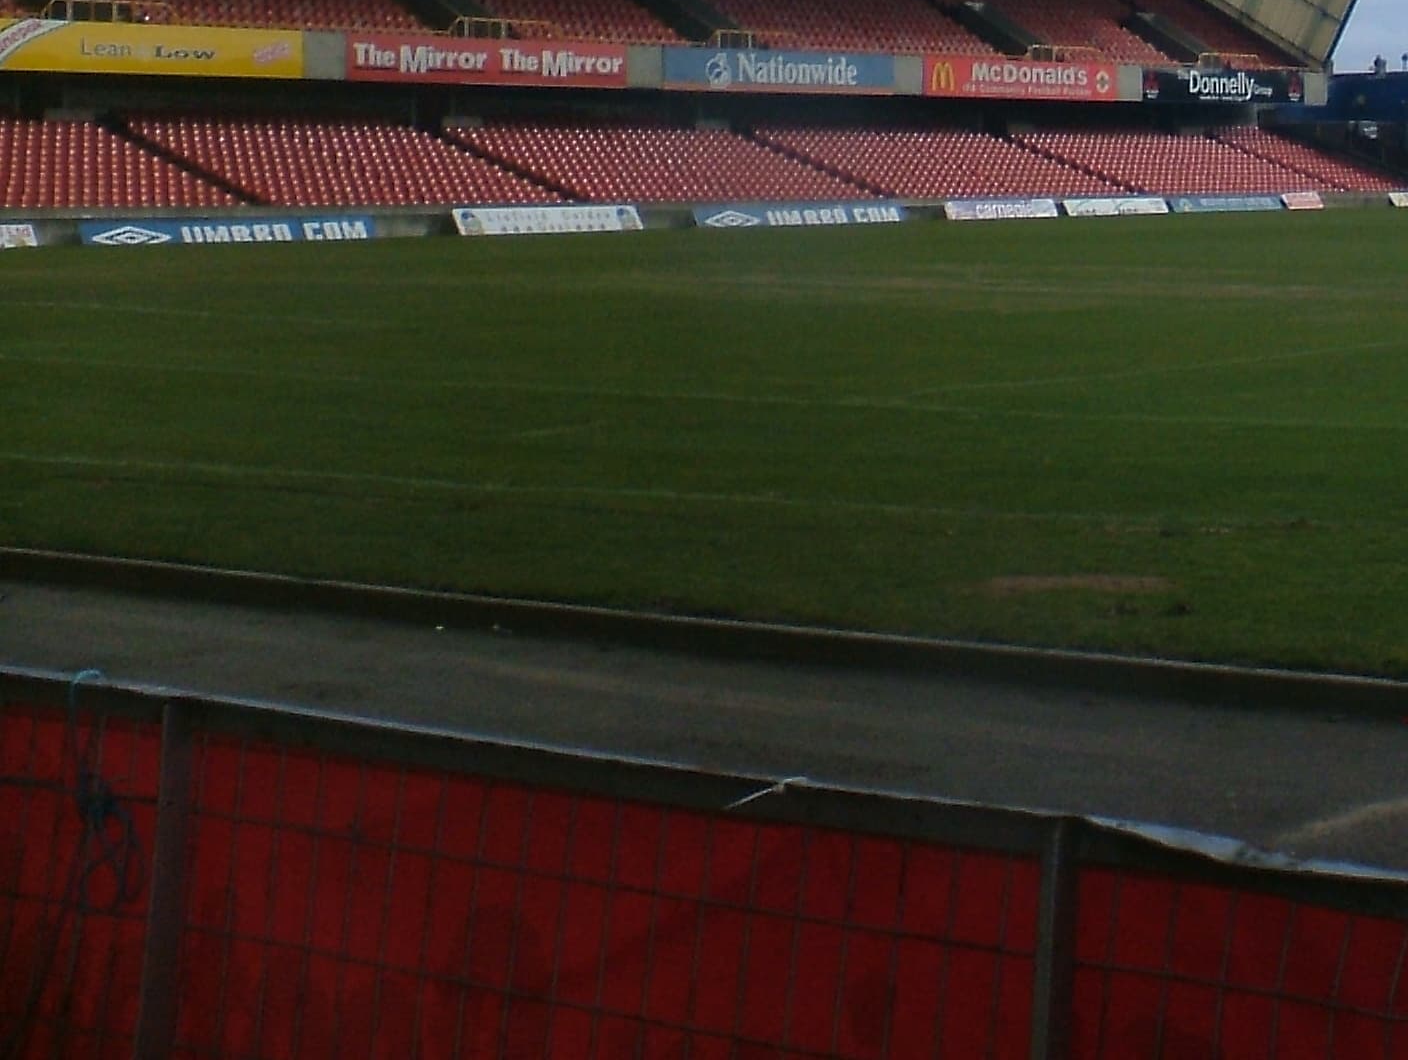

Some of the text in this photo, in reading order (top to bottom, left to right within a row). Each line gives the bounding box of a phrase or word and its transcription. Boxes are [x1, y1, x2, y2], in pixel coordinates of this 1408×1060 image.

[81, 37, 132, 56] Lean
[155, 45, 215, 60] Low
[353, 43, 623, 77] The Mirror The Mirror
[738, 53, 858, 86] Nationwide
[972, 62, 1088, 85] McDonald's
[1189, 70, 1255, 101] Donnelly
